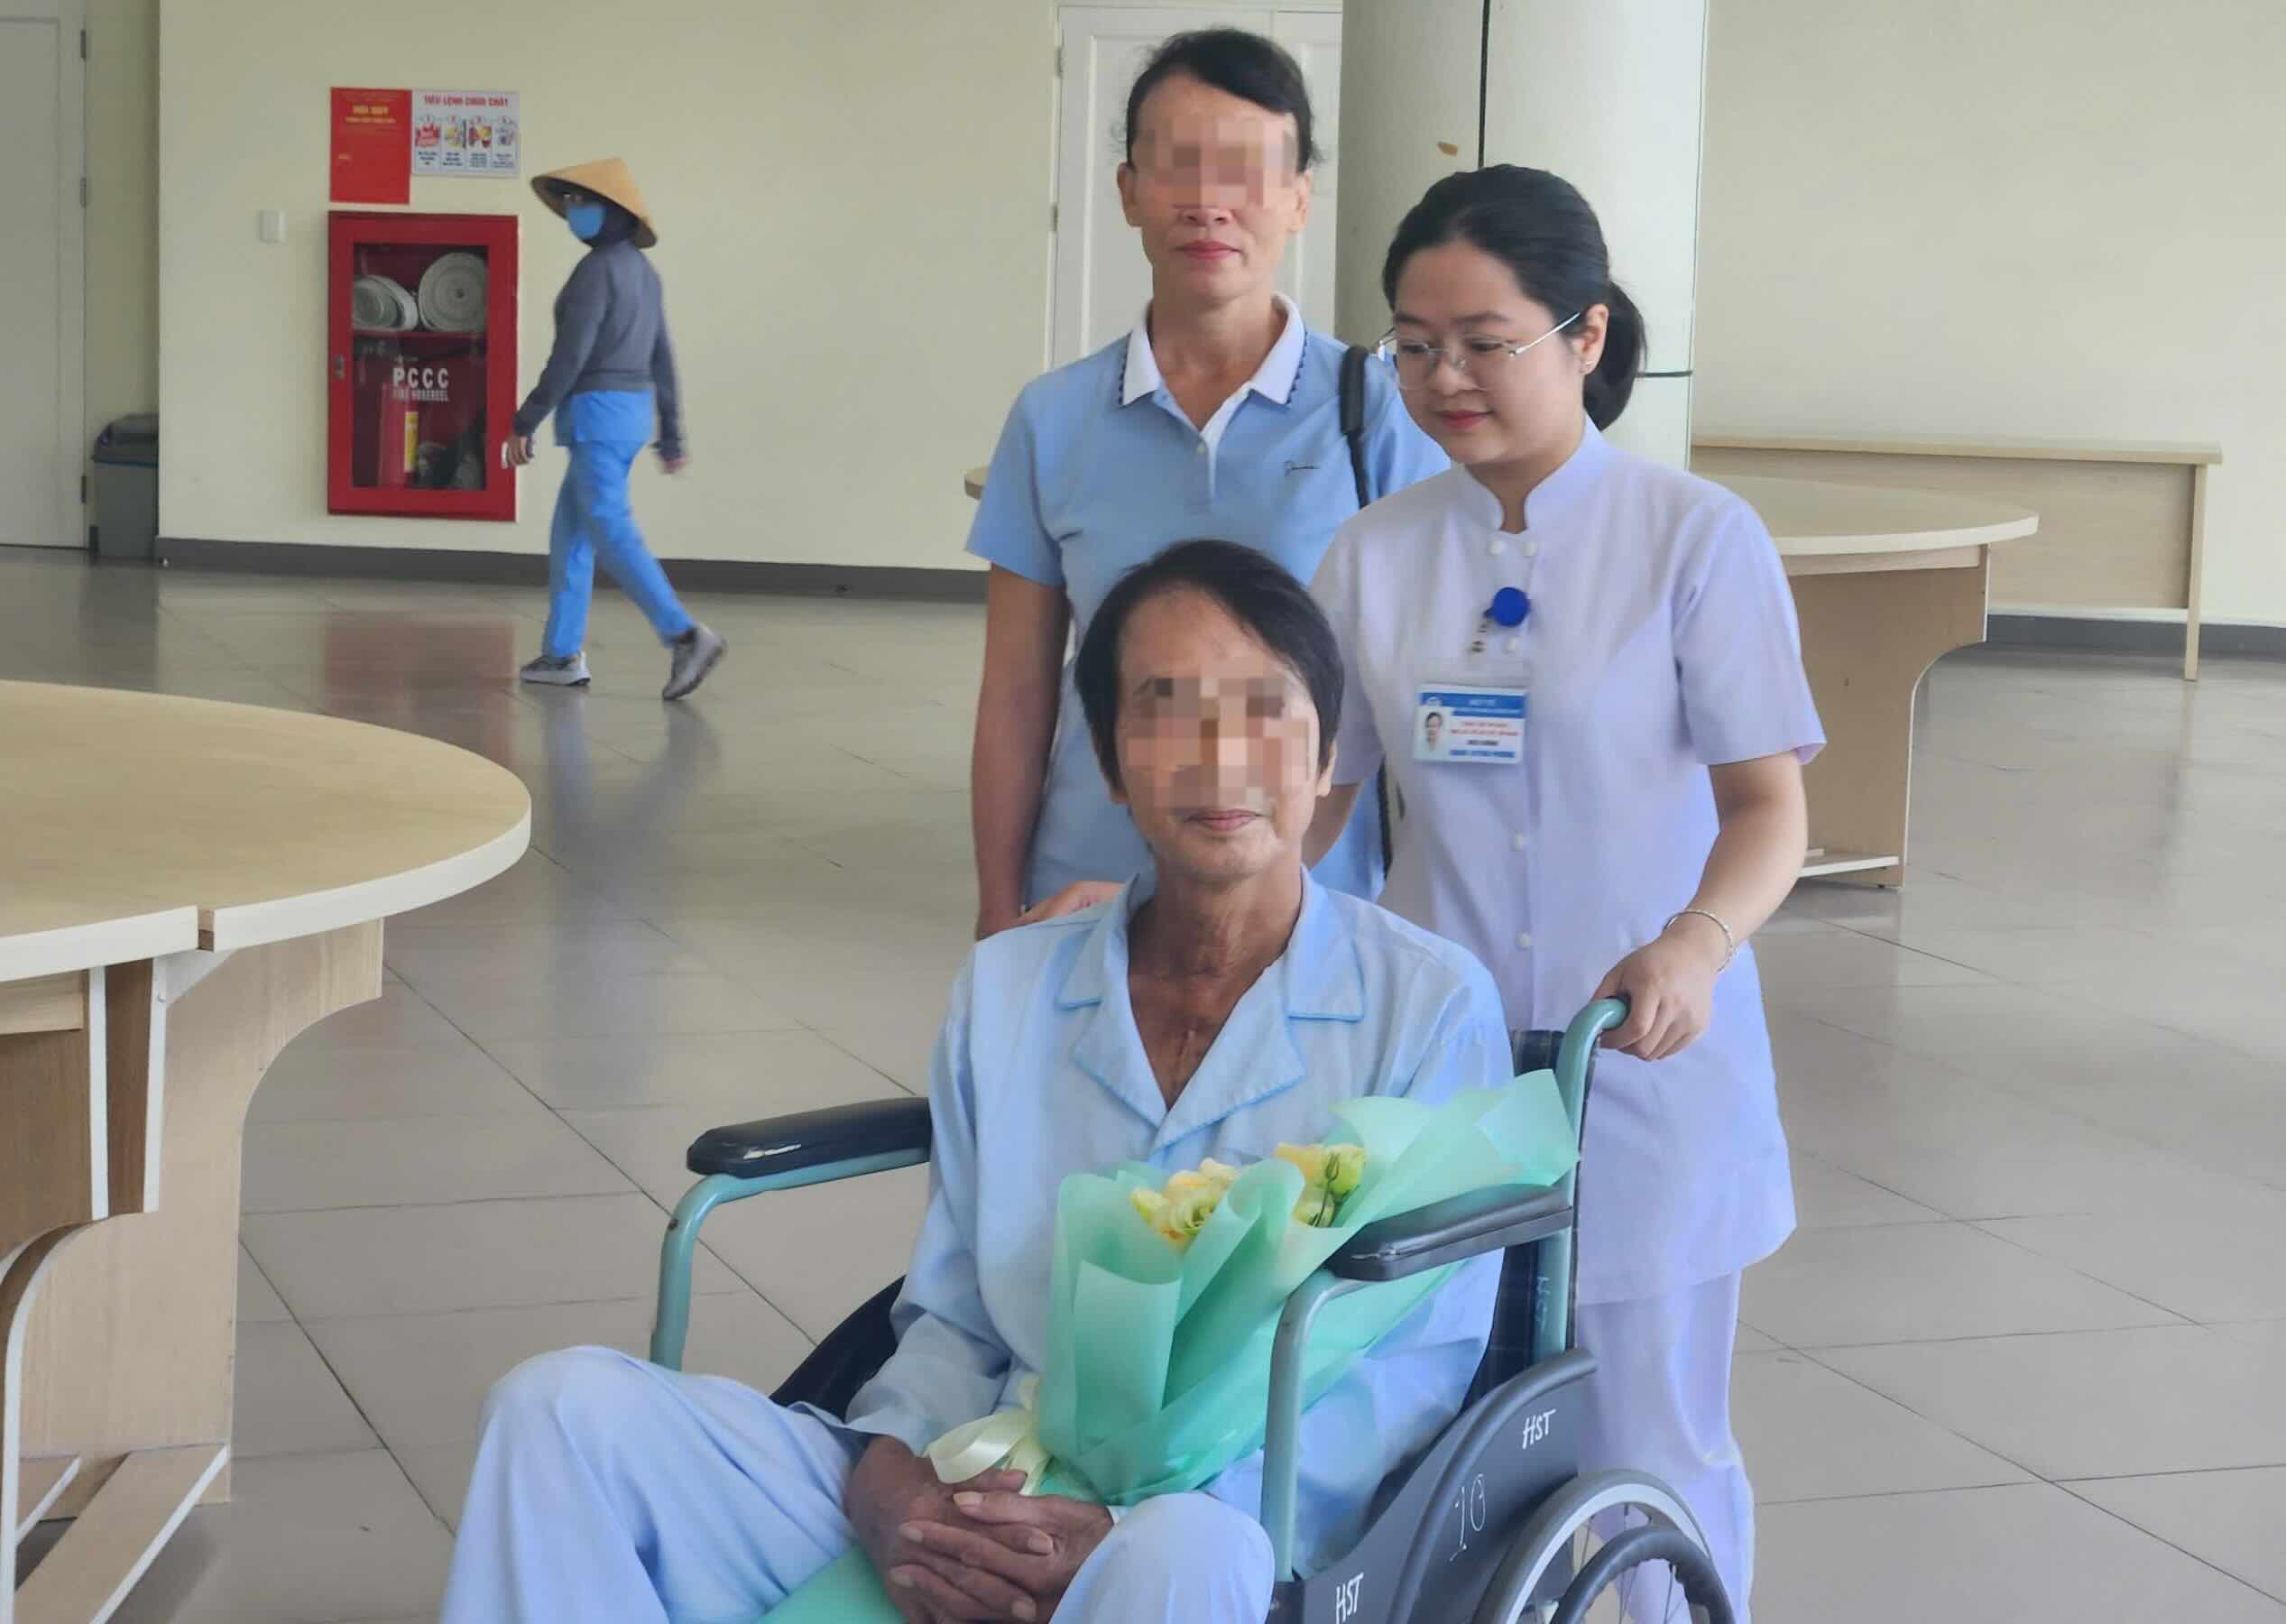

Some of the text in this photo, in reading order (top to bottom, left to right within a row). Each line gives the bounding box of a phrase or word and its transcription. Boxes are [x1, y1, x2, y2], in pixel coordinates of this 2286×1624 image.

[392, 367, 448, 389] PCCC
[1522, 1407, 1557, 1450] HST
[1450, 1472, 1487, 1562] 10
[1336, 1572, 1365, 1624] HST
